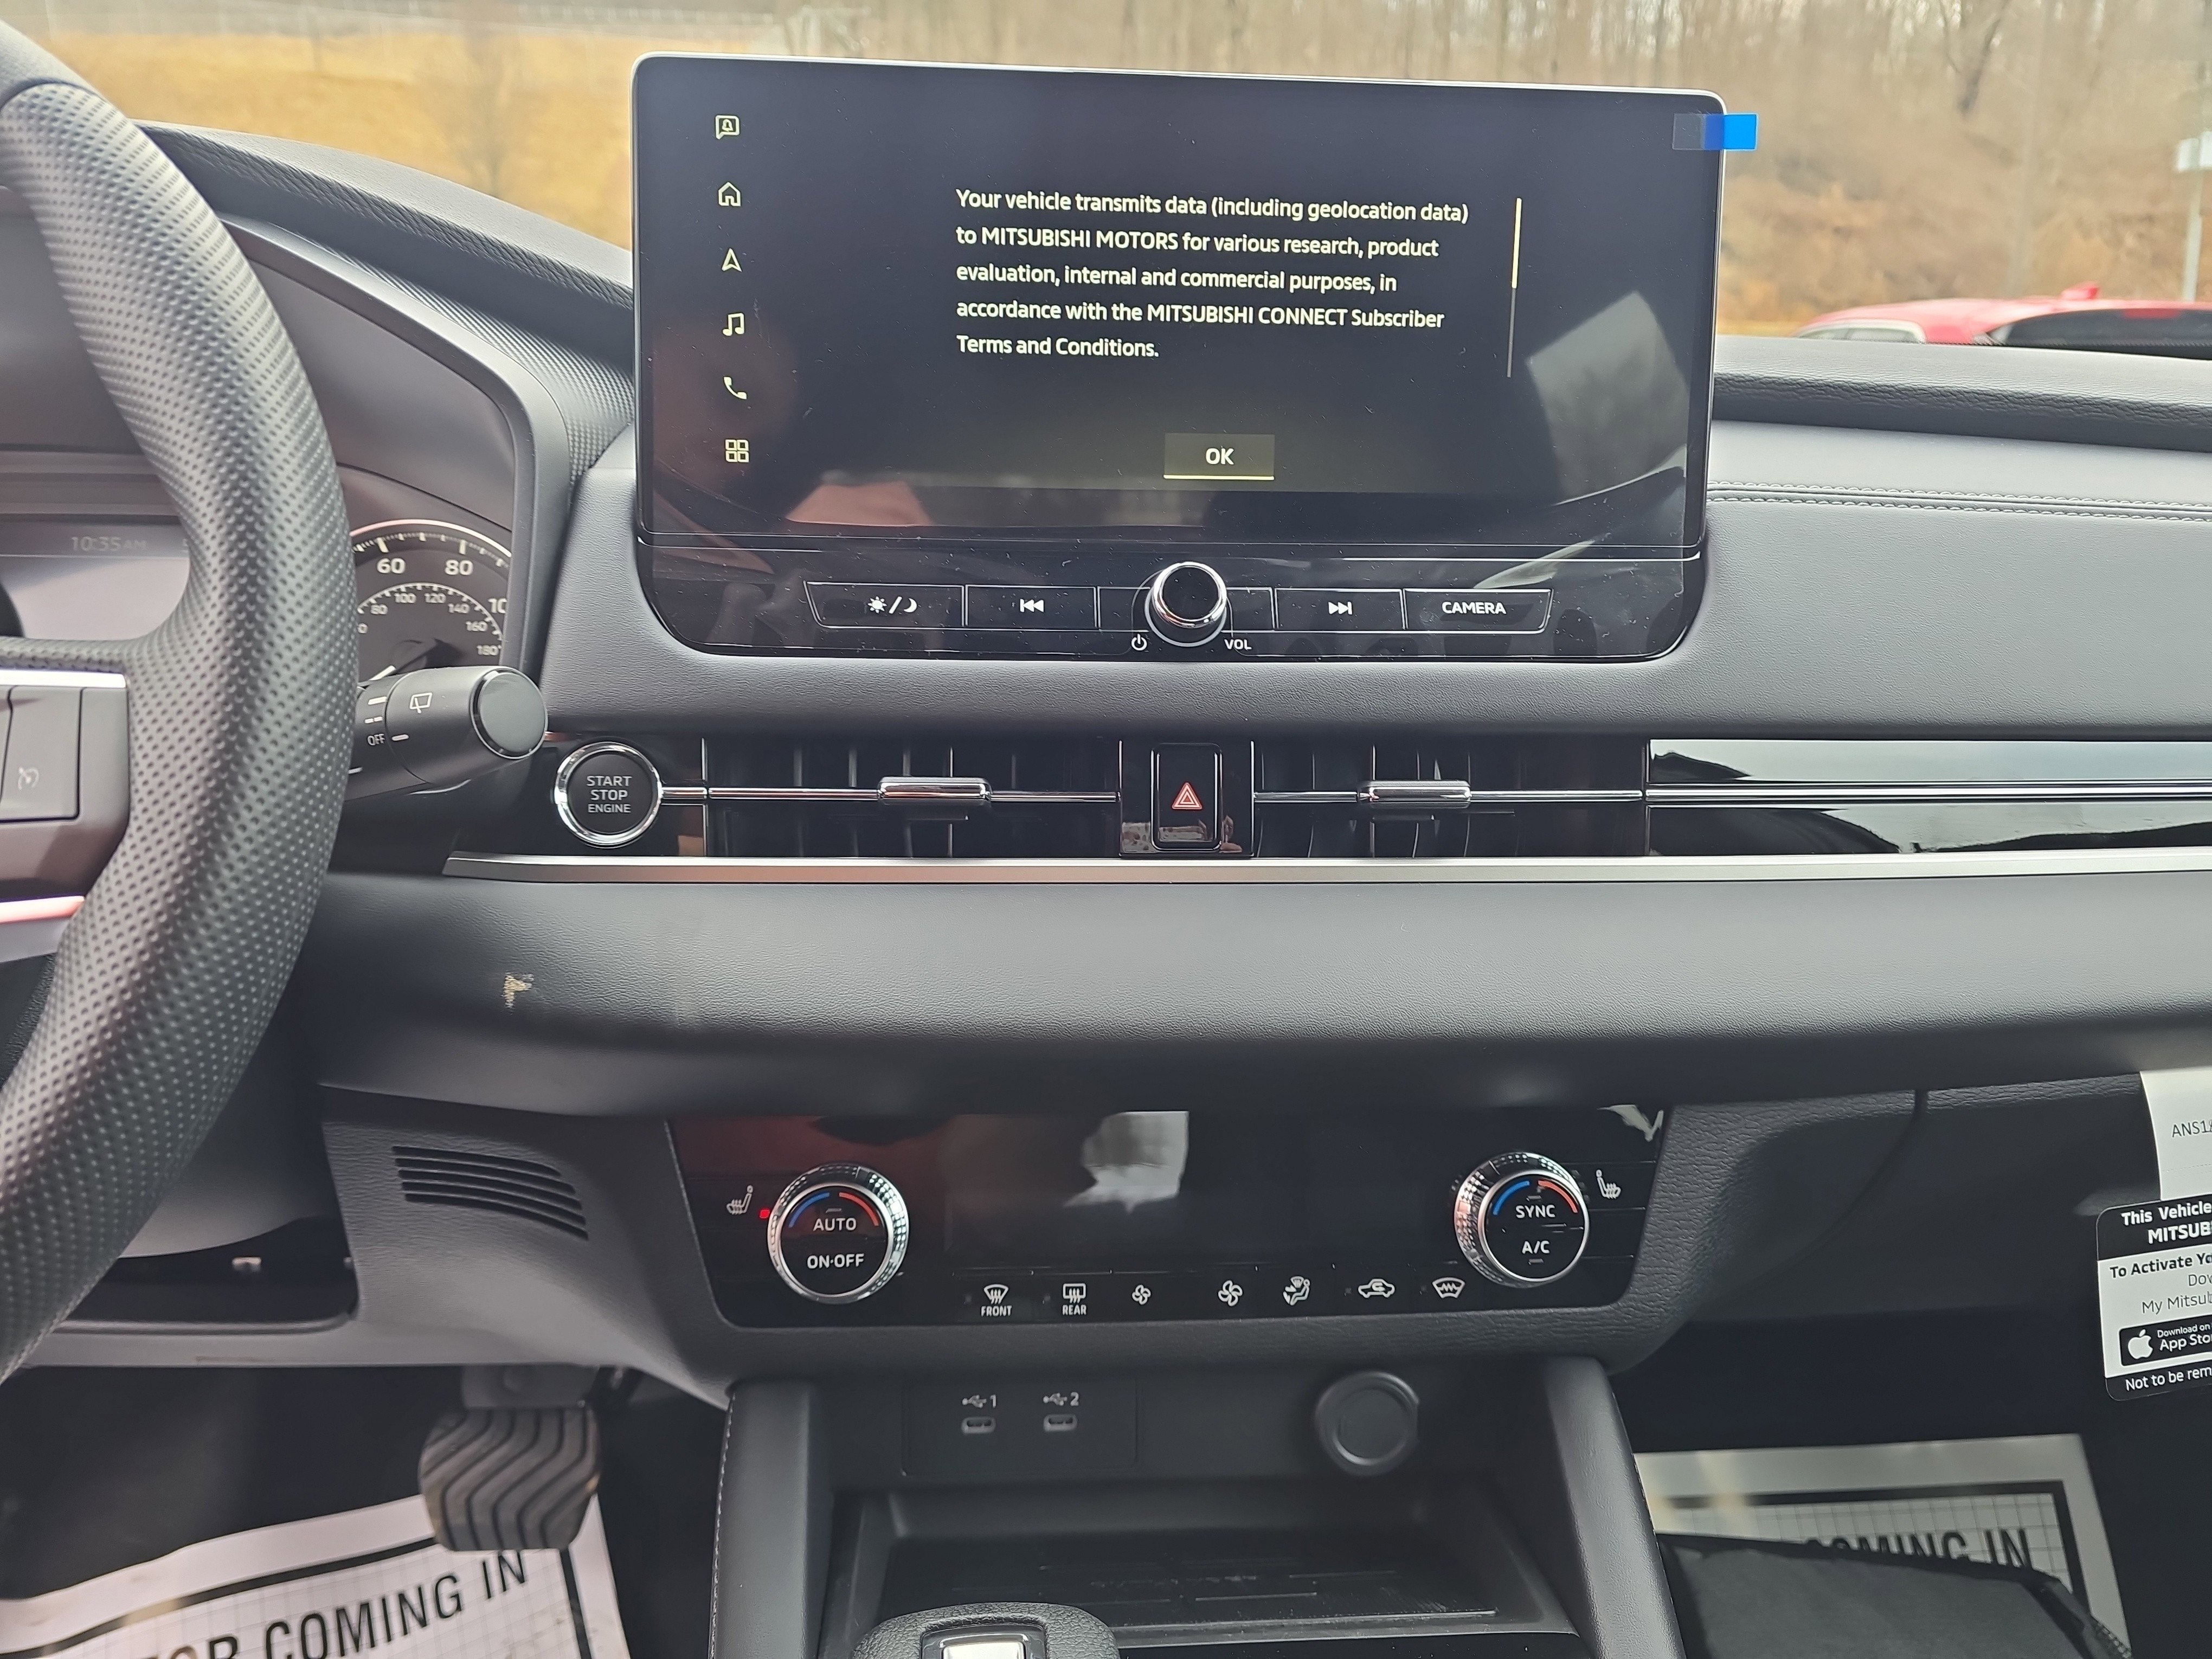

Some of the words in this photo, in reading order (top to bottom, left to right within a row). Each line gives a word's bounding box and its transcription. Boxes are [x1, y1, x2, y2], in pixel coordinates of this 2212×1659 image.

[955, 189, 1002, 208] Your
[1005, 191, 1071, 210] vehicle
[1075, 194, 1161, 213] transmits
[1165, 196, 1207, 215] data
[1212, 197, 1303, 221] (including
[1308, 201, 1416, 223] geolocation
[1420, 203, 1469, 224] data)
[956, 227, 976, 244] to
[982, 227, 1090, 247] MITSUBISHI
[1097, 230, 1178, 249] MOTORS
[1182, 232, 1210, 250] for
[1214, 234, 1279, 252] various
[1284, 237, 1363, 258] research,
[1368, 239, 1439, 259] product
[957, 263, 1060, 286] evaluation,
[1065, 266, 1136, 285] internal
[1141, 268, 1176, 286] and
[1181, 271, 1284, 288] commercial
[1290, 275, 1375, 294] purposes,
[1380, 274, 1397, 291] in
[957, 300, 1061, 319] accordance
[1065, 302, 1107, 320] with
[1111, 303, 1142, 321] the
[1148, 304, 1253, 324] MITSUBISHI
[1258, 307, 1348, 325] CONNECT
[1351, 308, 1444, 327] Subscriber
[956, 335, 1012, 353] Terms
[1016, 337, 1051, 355] and
[1056, 338, 1159, 357] Conditions.
[1205, 447, 1233, 465] OK
[376, 558, 406, 574] 60
[445, 560, 473, 575] 80
[488, 598, 508, 614] 10
[357, 623, 368, 634] 0
[394, 593, 416, 603] 100
[425, 593, 446, 603] 120
[448, 603, 470, 614] 140
[466, 621, 488, 632] 160
[1441, 601, 1506, 615] CAMERA
[1224, 638, 1252, 650] VOL
[367, 734, 385, 746] OFF
[586, 775, 633, 787] START
[590, 789, 628, 801] STOP
[587, 803, 632, 813] ENGINE
[1516, 1205, 1555, 1219] SYNC
[2121, 1210, 2153, 1226] This
[2158, 1201, 2212, 1220] Vehicle
[813, 1217, 857, 1232] AUTO
[2148, 1221, 2212, 1244] MITSUB
[1522, 1240, 1550, 1254] A/C
[2110, 1266, 2127, 1278] To
[2131, 1256, 2192, 1275] Activate
[980, 1305, 1012, 1317] FRONT
[1061, 1304, 1087, 1316] REAR
[2142, 1300, 2163, 1315] My
[2157, 1324, 2198, 1338] Download
[2200, 1323, 2210, 1332] on
[2159, 1338, 2188, 1352] App
[2125, 1377, 2149, 1391] Not
[2151, 1373, 2166, 1386] to
[2169, 1371, 2184, 1383] be
[990, 1394, 997, 1408] 1
[1070, 1392, 1079, 1406] 2
[265, 1574, 463, 1659] COMING
[482, 1549, 528, 1599] IN
